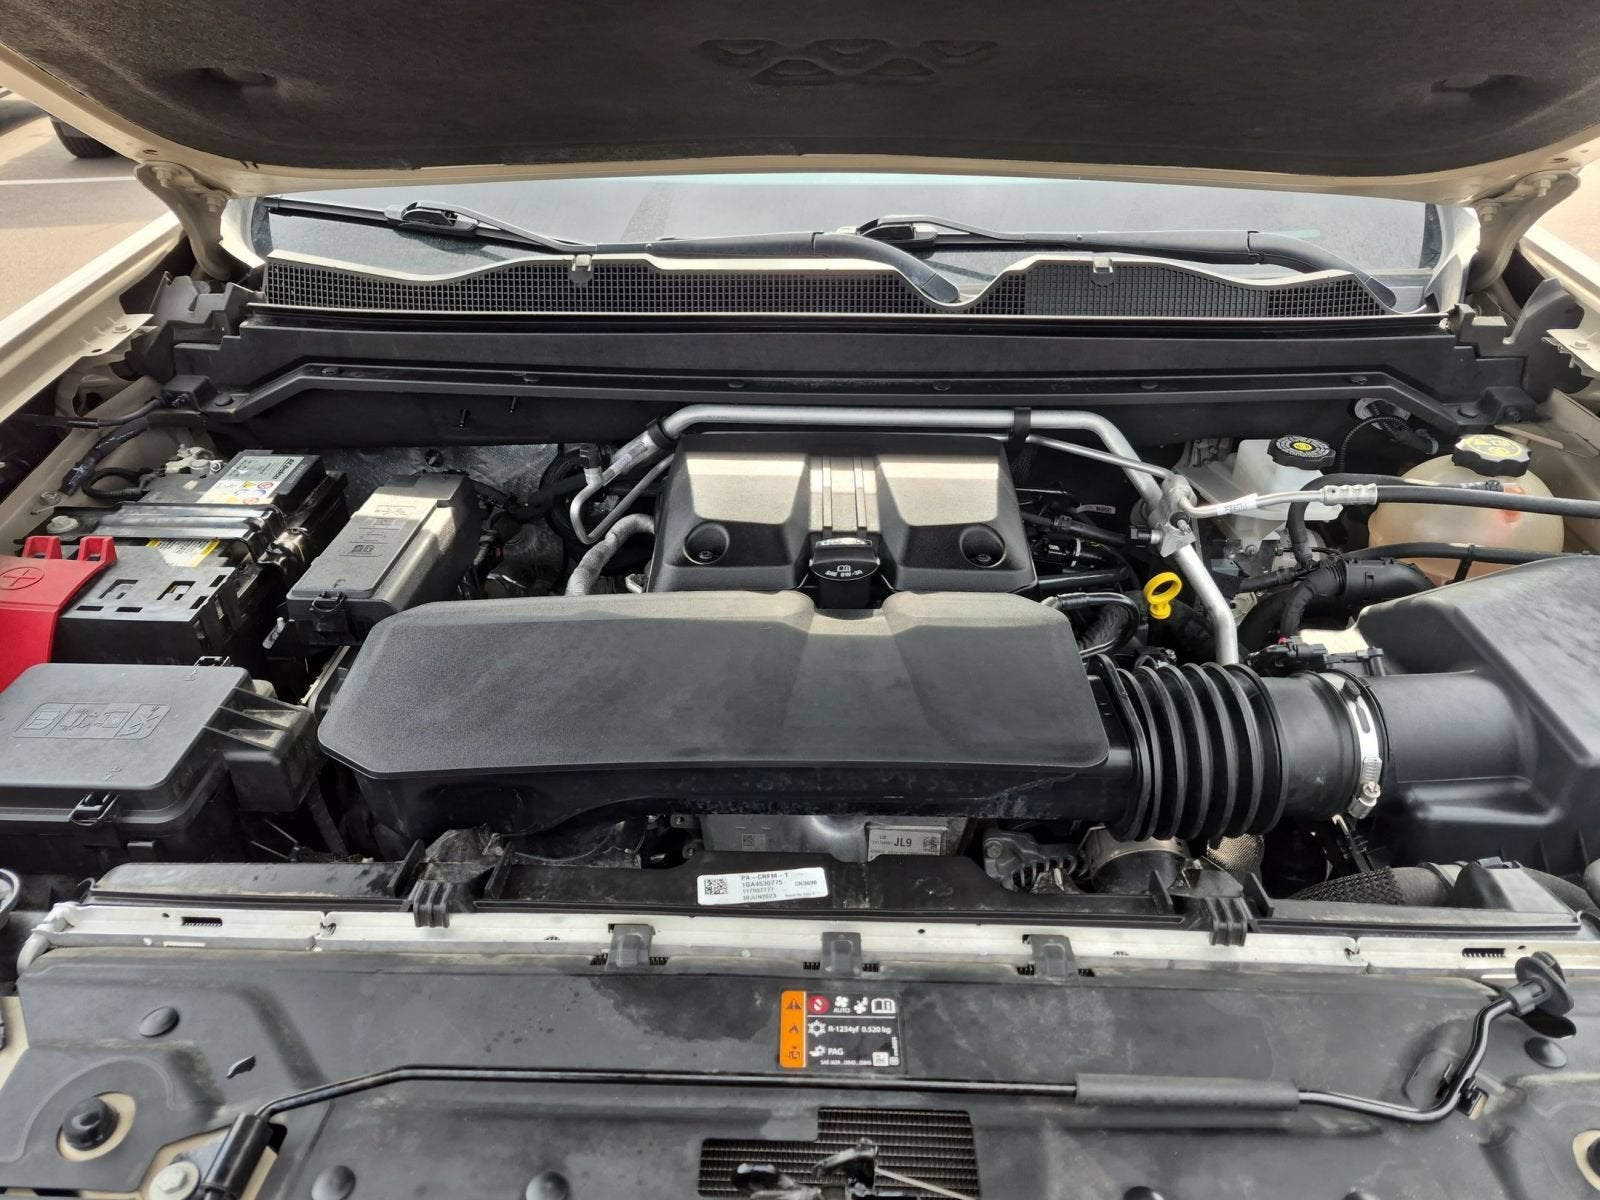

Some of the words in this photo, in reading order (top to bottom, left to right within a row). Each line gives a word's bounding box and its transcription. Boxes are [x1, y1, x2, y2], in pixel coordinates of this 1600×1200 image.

[893, 837, 912, 847] JL9
[828, 1025, 860, 1034] R-1234yf
[861, 1026, 881, 1034] 0.520
[881, 1026, 892, 1035] kg
[827, 1047, 844, 1056] PAG
